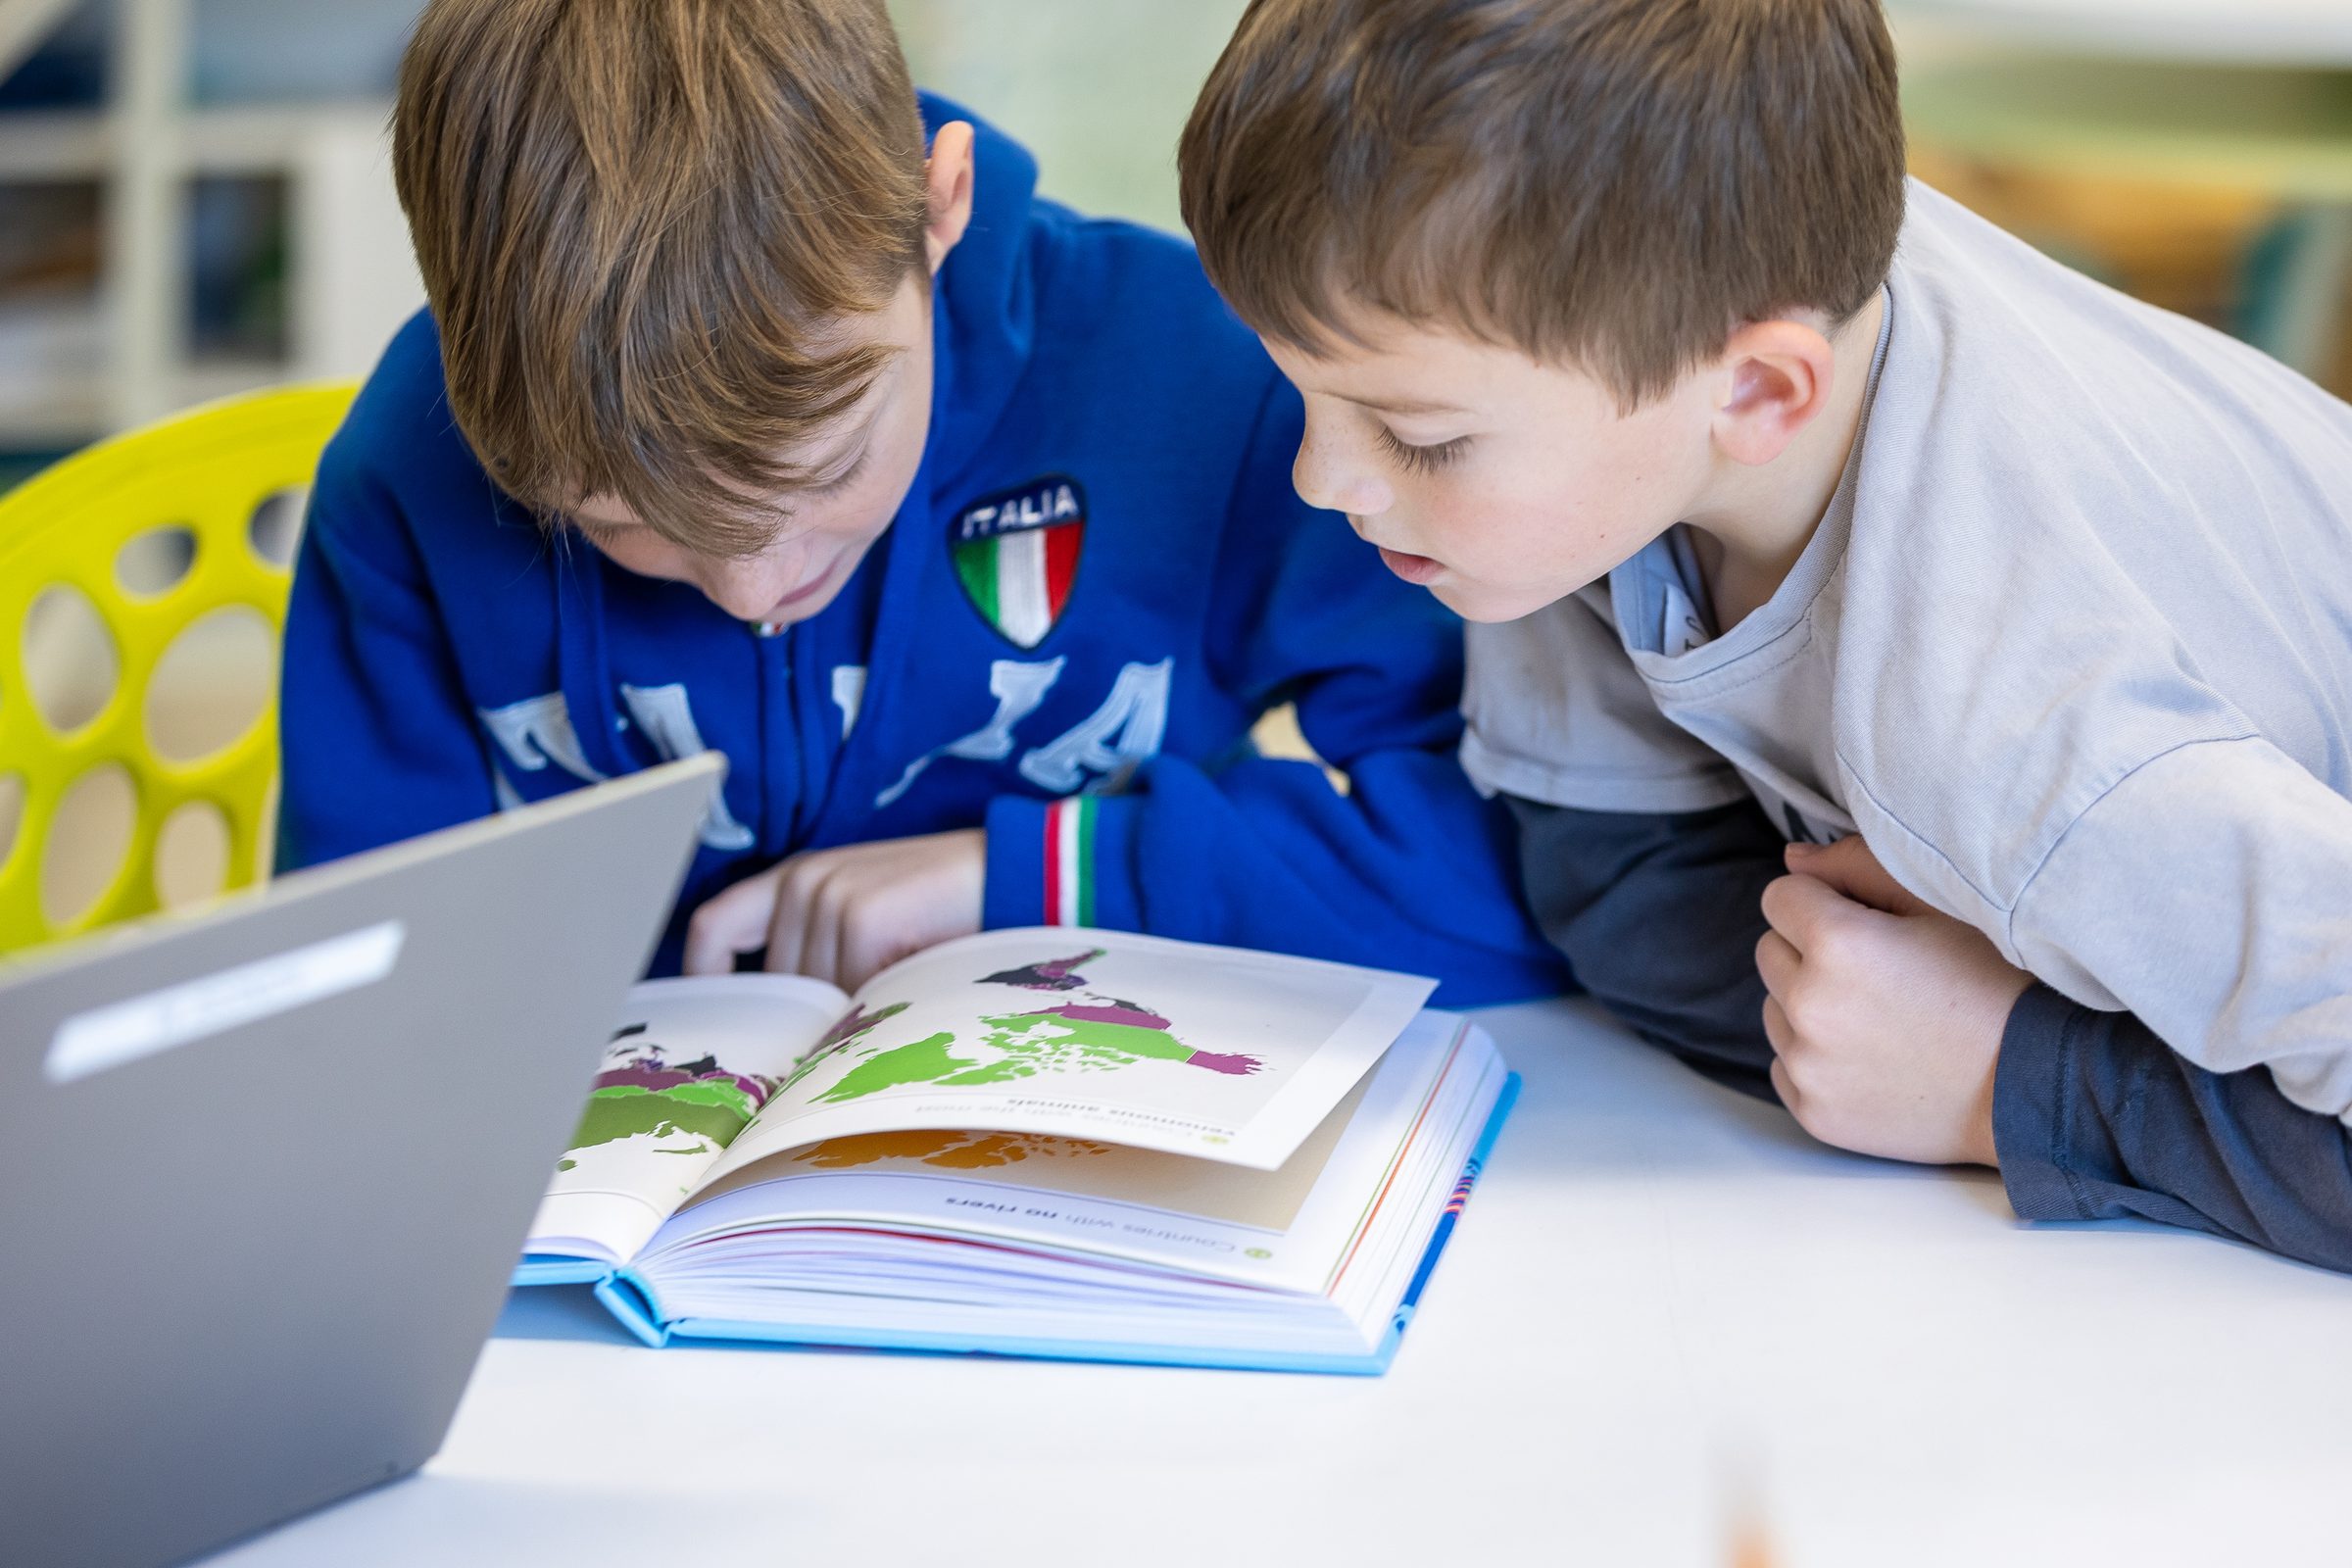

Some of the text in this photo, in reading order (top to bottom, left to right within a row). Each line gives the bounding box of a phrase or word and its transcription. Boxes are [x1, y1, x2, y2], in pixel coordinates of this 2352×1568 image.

[961, 484, 1080, 540] ITALIA
[1007, 1098, 1101, 1113] animals
[945, 1197, 1236, 1253] Countries with no rivers
